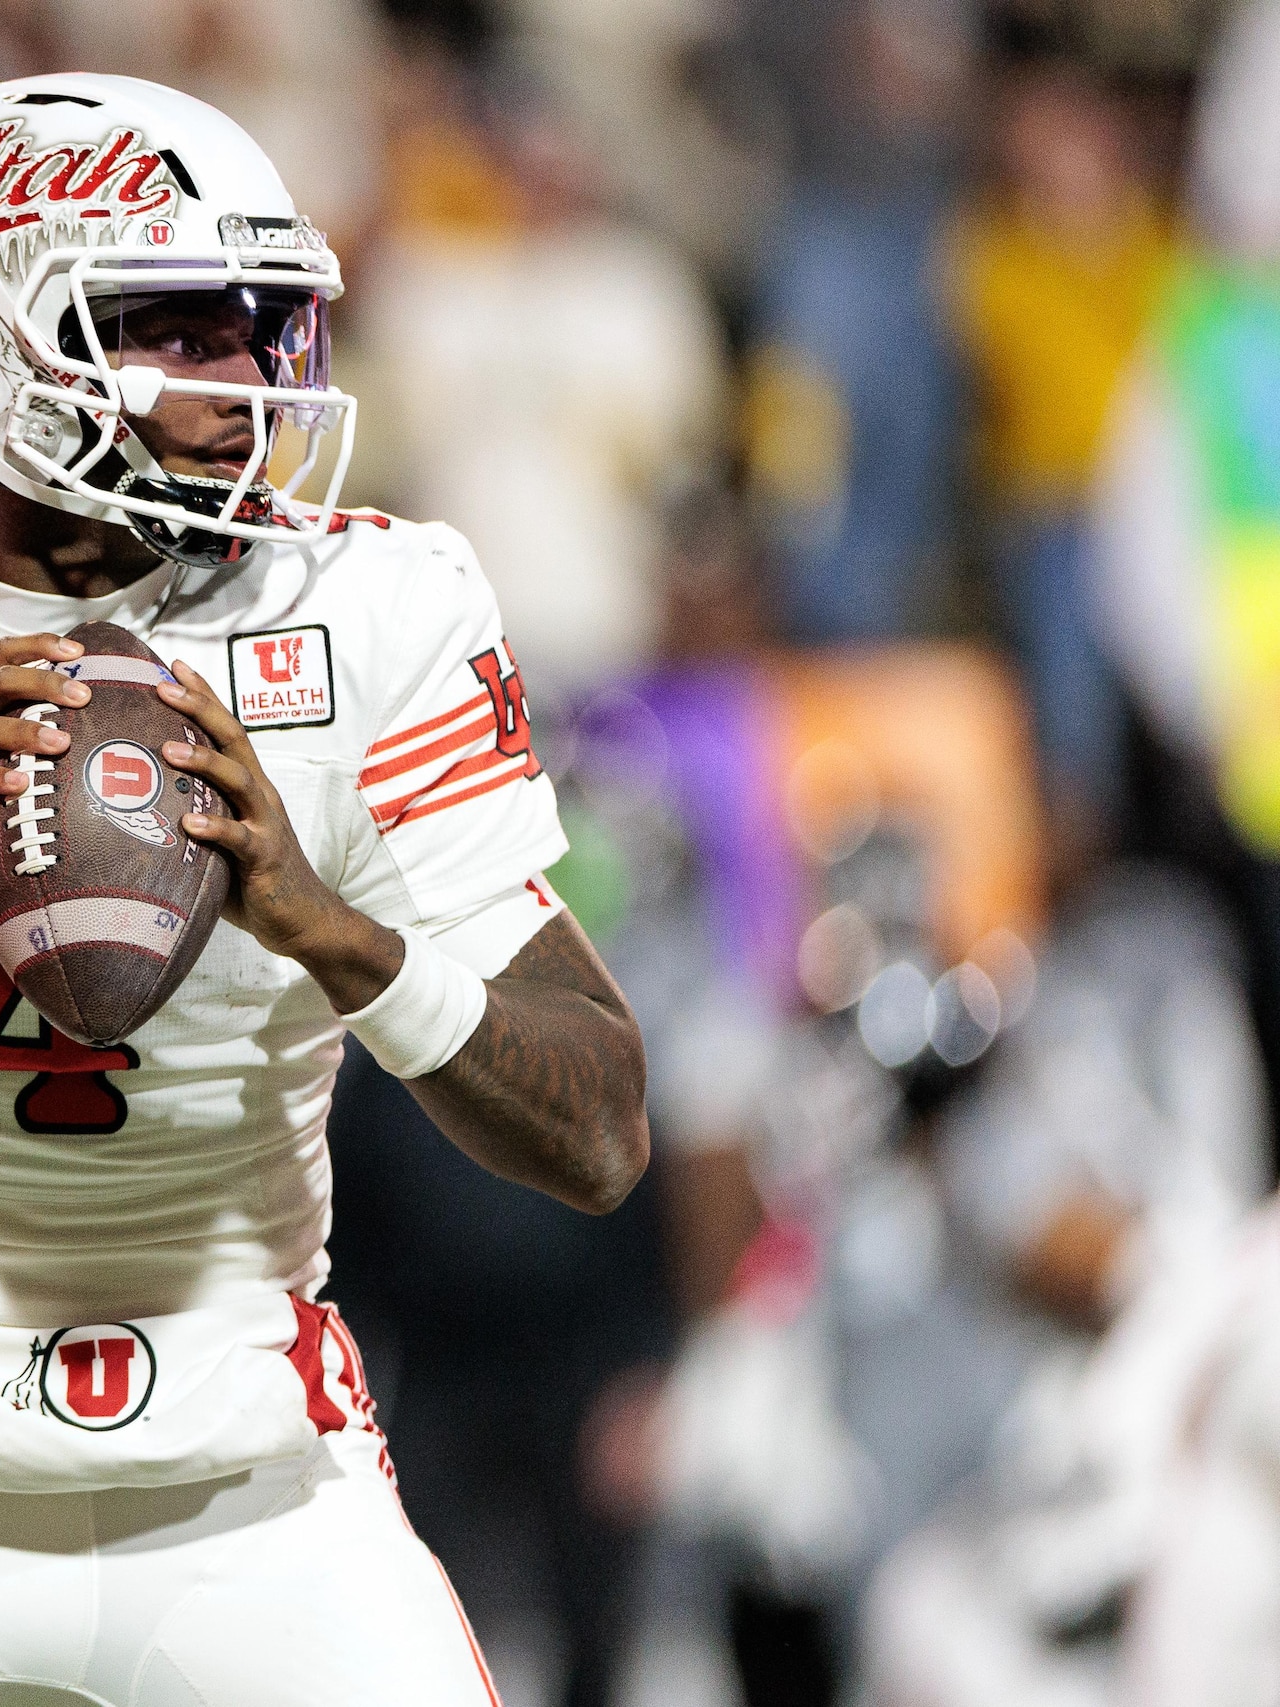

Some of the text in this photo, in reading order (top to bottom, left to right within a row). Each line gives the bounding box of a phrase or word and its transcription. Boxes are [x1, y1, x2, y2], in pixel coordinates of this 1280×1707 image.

[152, 225, 169, 244] U
[242, 687, 324, 710] HEALTH
[243, 708, 326, 722] UNIVERSITY OF UTAH
[101, 752, 153, 799] U
[182, 793, 204, 864] TEM
[58, 1338, 136, 1417] U
